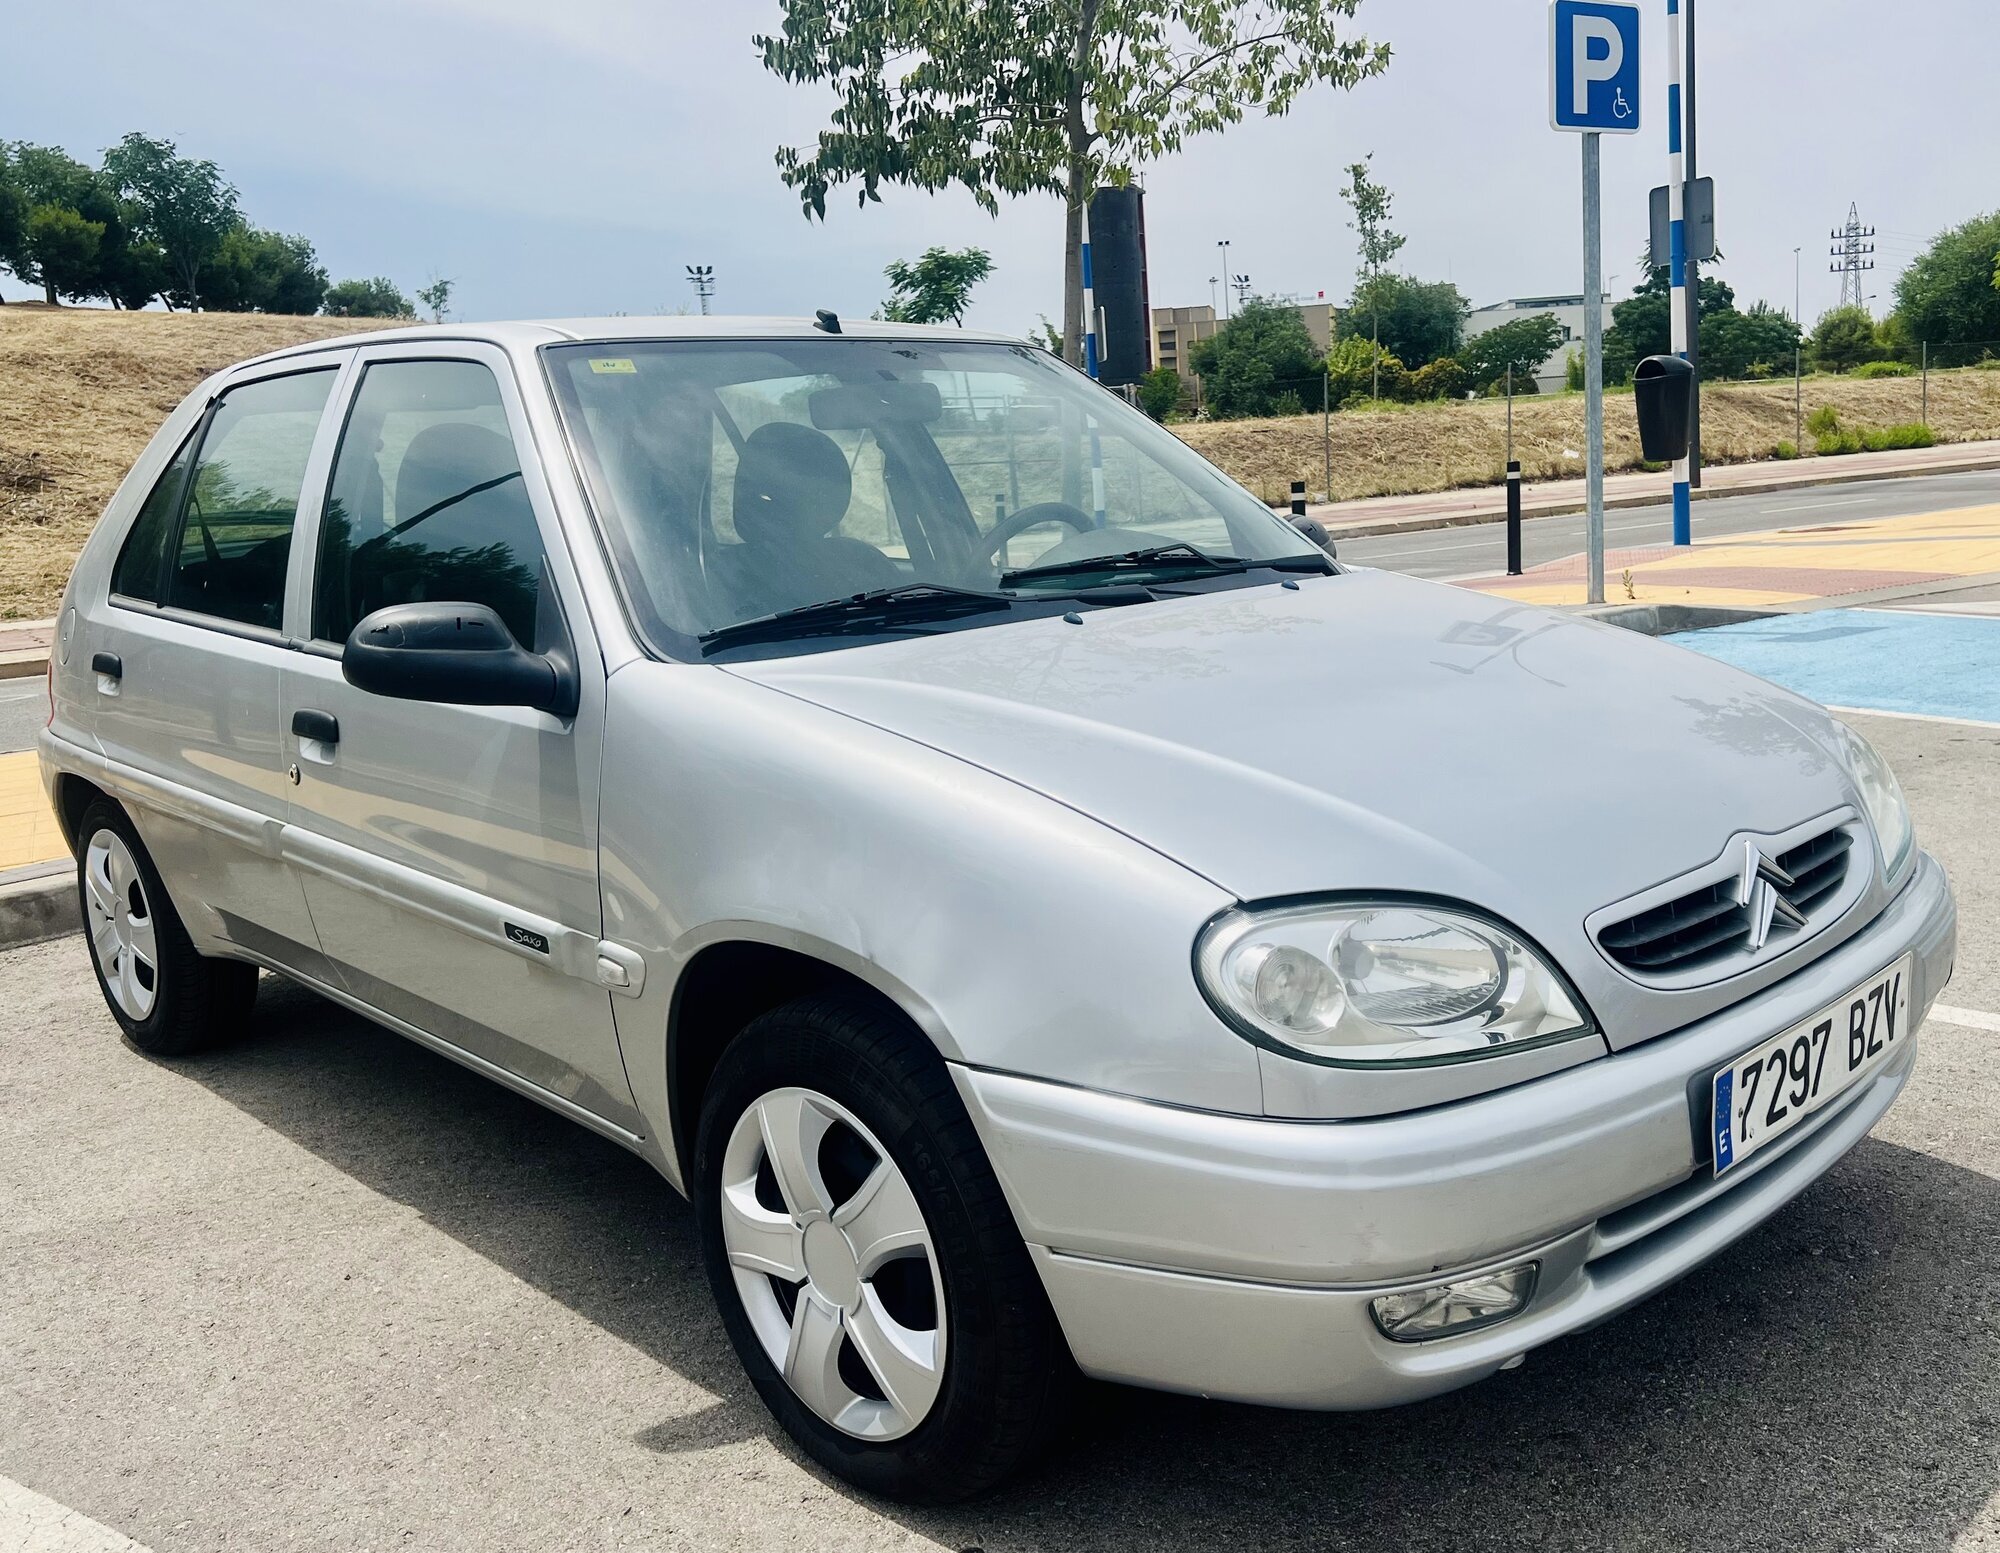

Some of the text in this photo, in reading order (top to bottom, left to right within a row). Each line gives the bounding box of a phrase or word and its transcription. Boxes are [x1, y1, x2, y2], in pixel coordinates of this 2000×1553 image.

[1573, 14, 1623, 114] P
[510, 929, 541, 948] Saxo
[1741, 971, 1900, 1143] 7297 BZV
[1719, 1128, 1729, 1154] E
